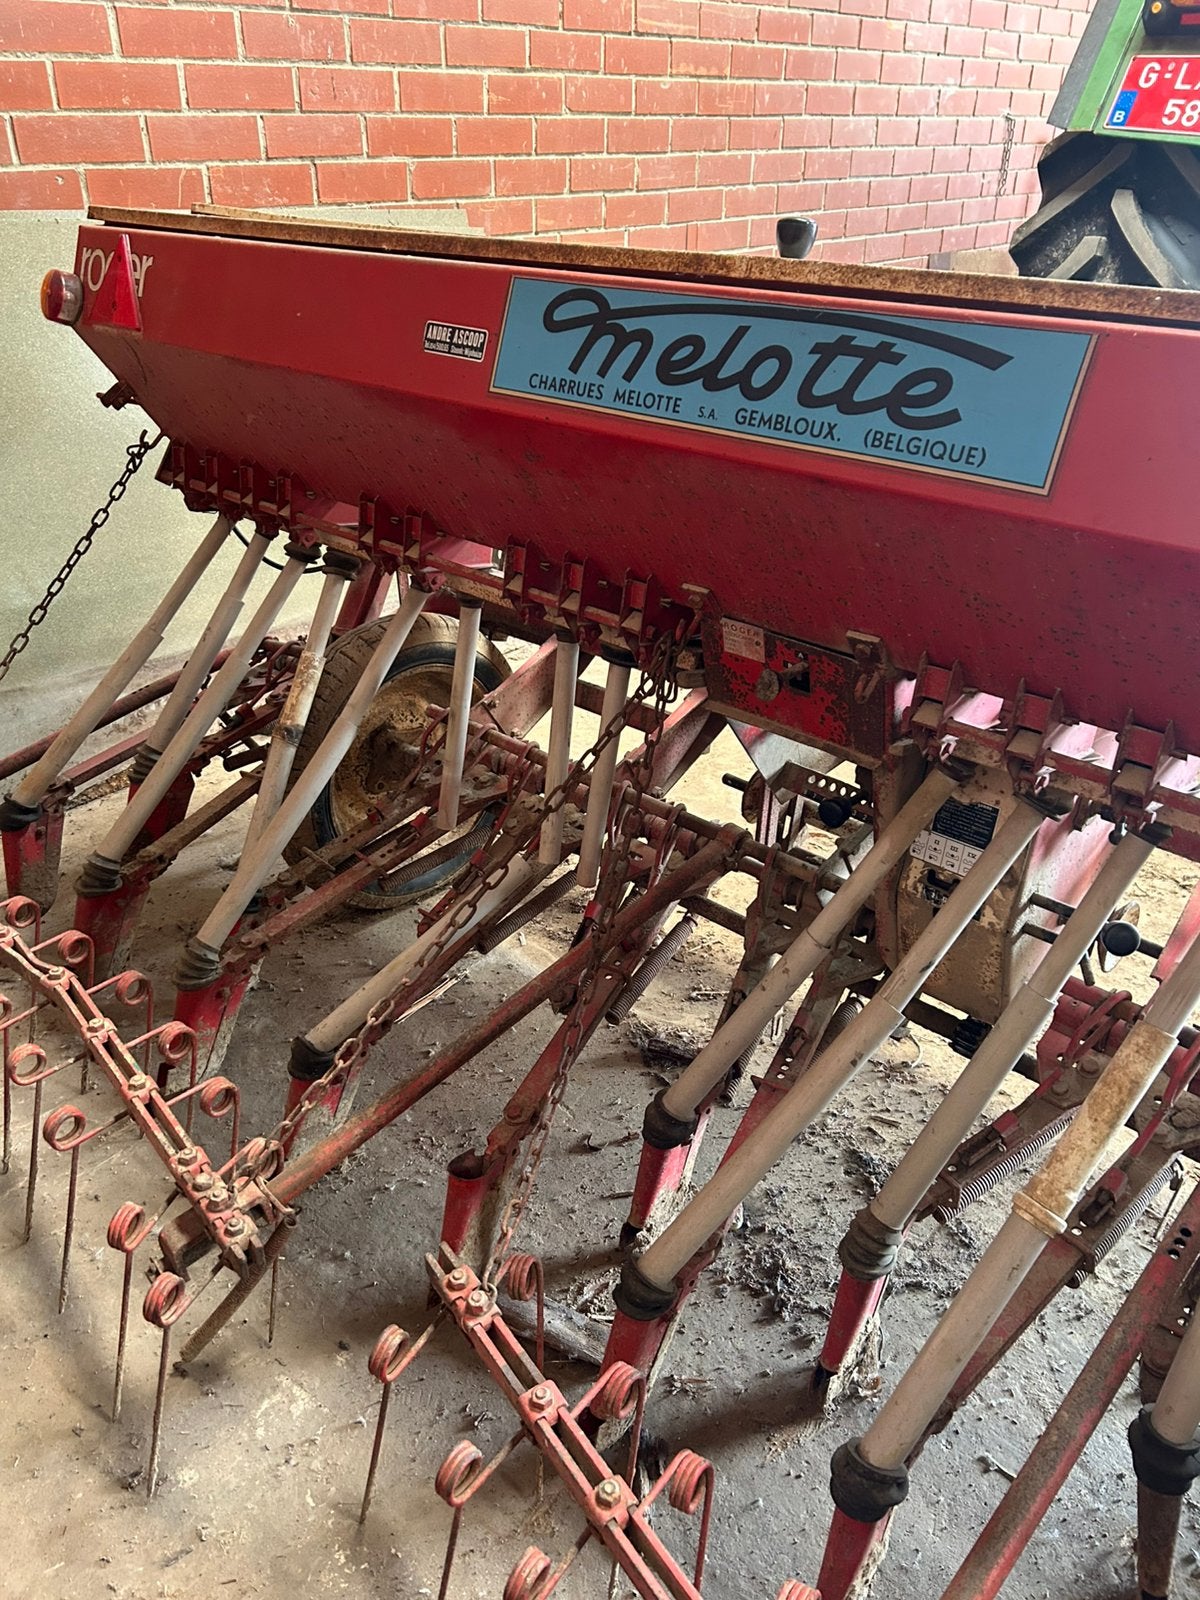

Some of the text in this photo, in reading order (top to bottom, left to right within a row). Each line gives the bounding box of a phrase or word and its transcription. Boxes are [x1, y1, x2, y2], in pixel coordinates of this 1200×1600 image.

[1113, 110, 1125, 123] B
[427, 325, 453, 343] ANDRE
[453, 329, 485, 348] ASCOOP
[543, 288, 1014, 431] melotte
[529, 372, 987, 469] CHARRUES MELOTTE S.A. GEMBLOUX. (BELGIQUE)
